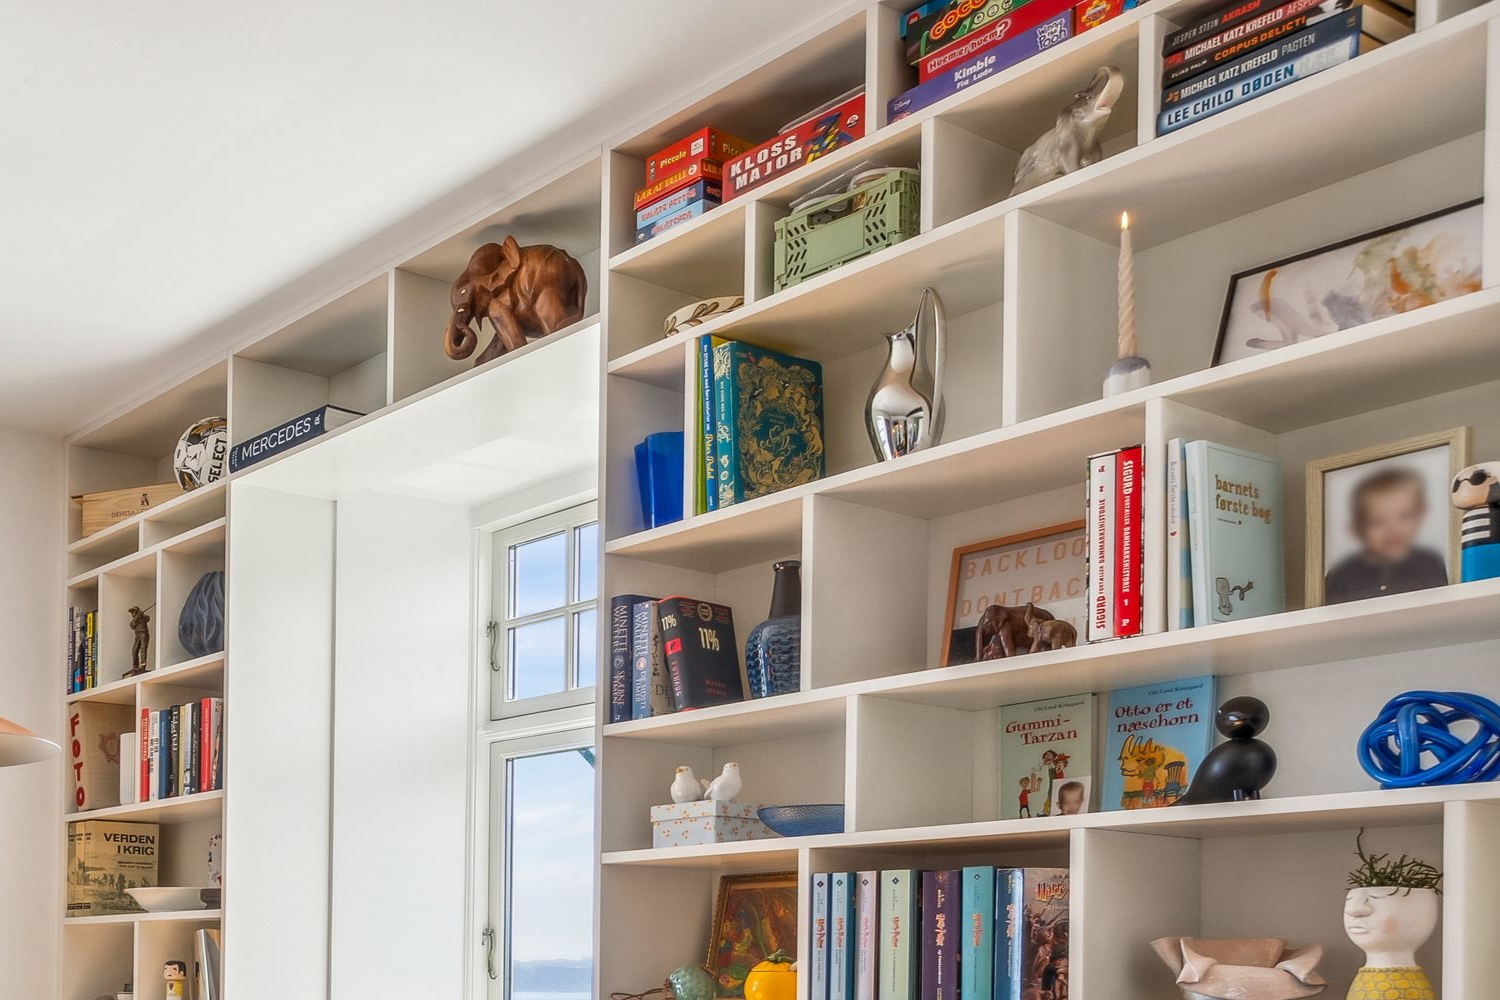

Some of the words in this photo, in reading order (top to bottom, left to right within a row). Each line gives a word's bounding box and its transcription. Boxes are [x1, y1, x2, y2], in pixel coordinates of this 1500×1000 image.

[1039, 29, 1068, 50] Pooh
[1172, 26, 1198, 46] JESPER
[1198, 19, 1219, 36] STEIN
[1184, 34, 1222, 60] MICHAEL
[1222, 25, 1245, 45] KATZ
[1245, 10, 1283, 34] KREFELD
[1214, 37, 1259, 61] CORPUS
[1259, 16, 1307, 43] DELICTI
[954, 54, 997, 83] Kimble
[1180, 76, 1217, 100] MICHAEL
[1218, 66, 1240, 84] KATZ
[1241, 49, 1278, 76] KREFELD
[1281, 33, 1316, 57] PAGTEN
[1167, 105, 1190, 127] LEE
[1192, 88, 1234, 116] CHILD
[1241, 63, 1295, 96] DØDEN
[659, 150, 687, 170] Piccolo
[730, 134, 798, 178] KLOSS
[735, 146, 803, 190] MAJOR
[241, 417, 311, 461] MERCEDES
[706, 433, 714, 455] Peter
[208, 437, 227, 484] SELECT
[706, 456, 715, 480] Pedal
[1214, 474, 1259, 499] barnets
[1215, 493, 1249, 516] første
[1251, 502, 1272, 525] bog
[964, 549, 1029, 581] BACK
[1035, 537, 1086, 566] LOO
[1030, 577, 1081, 604] BAC
[613, 606, 621, 654] WALTERS
[621, 605, 629, 653] MINETTE
[641, 611, 649, 657] MINETTE
[662, 614, 677, 631] 11%
[699, 627, 720, 652] 11%
[1115, 703, 1154, 719] Otto
[1156, 702, 1172, 714] er
[1176, 697, 1193, 711] et
[1006, 714, 1070, 734] Gummi-
[1117, 713, 1200, 733] næsehorn
[1021, 729, 1078, 746] Tarzan
[69, 712, 85, 807] FOTO
[103, 833, 155, 845] VERDEN
[123, 846, 155, 856] KRIG
[1035, 882, 1068, 902] Harry
